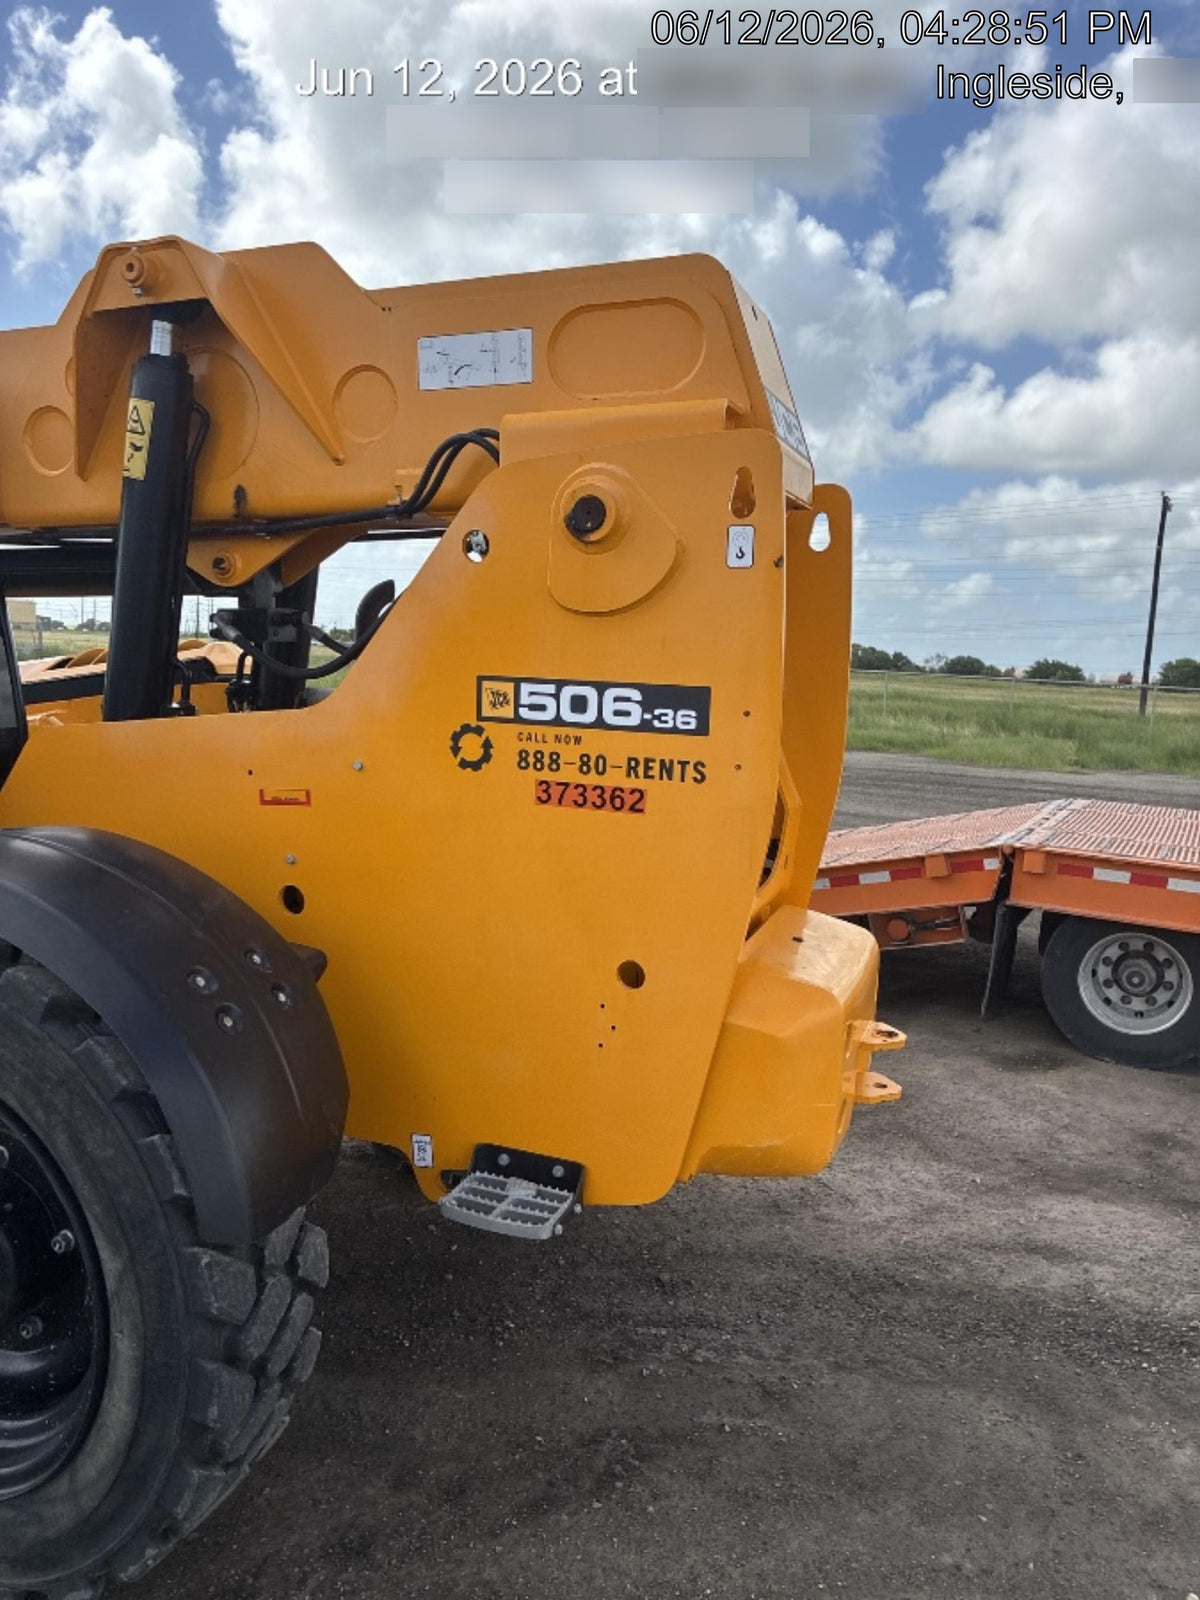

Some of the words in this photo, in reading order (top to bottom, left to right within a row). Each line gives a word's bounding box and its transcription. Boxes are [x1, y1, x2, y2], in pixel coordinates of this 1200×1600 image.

[518, 681, 698, 730] 506-36
[517, 732, 548, 743] CALL
[554, 734, 582, 745] NOW
[517, 749, 707, 784] 888-80-RENTS
[536, 780, 645, 813] 373362
